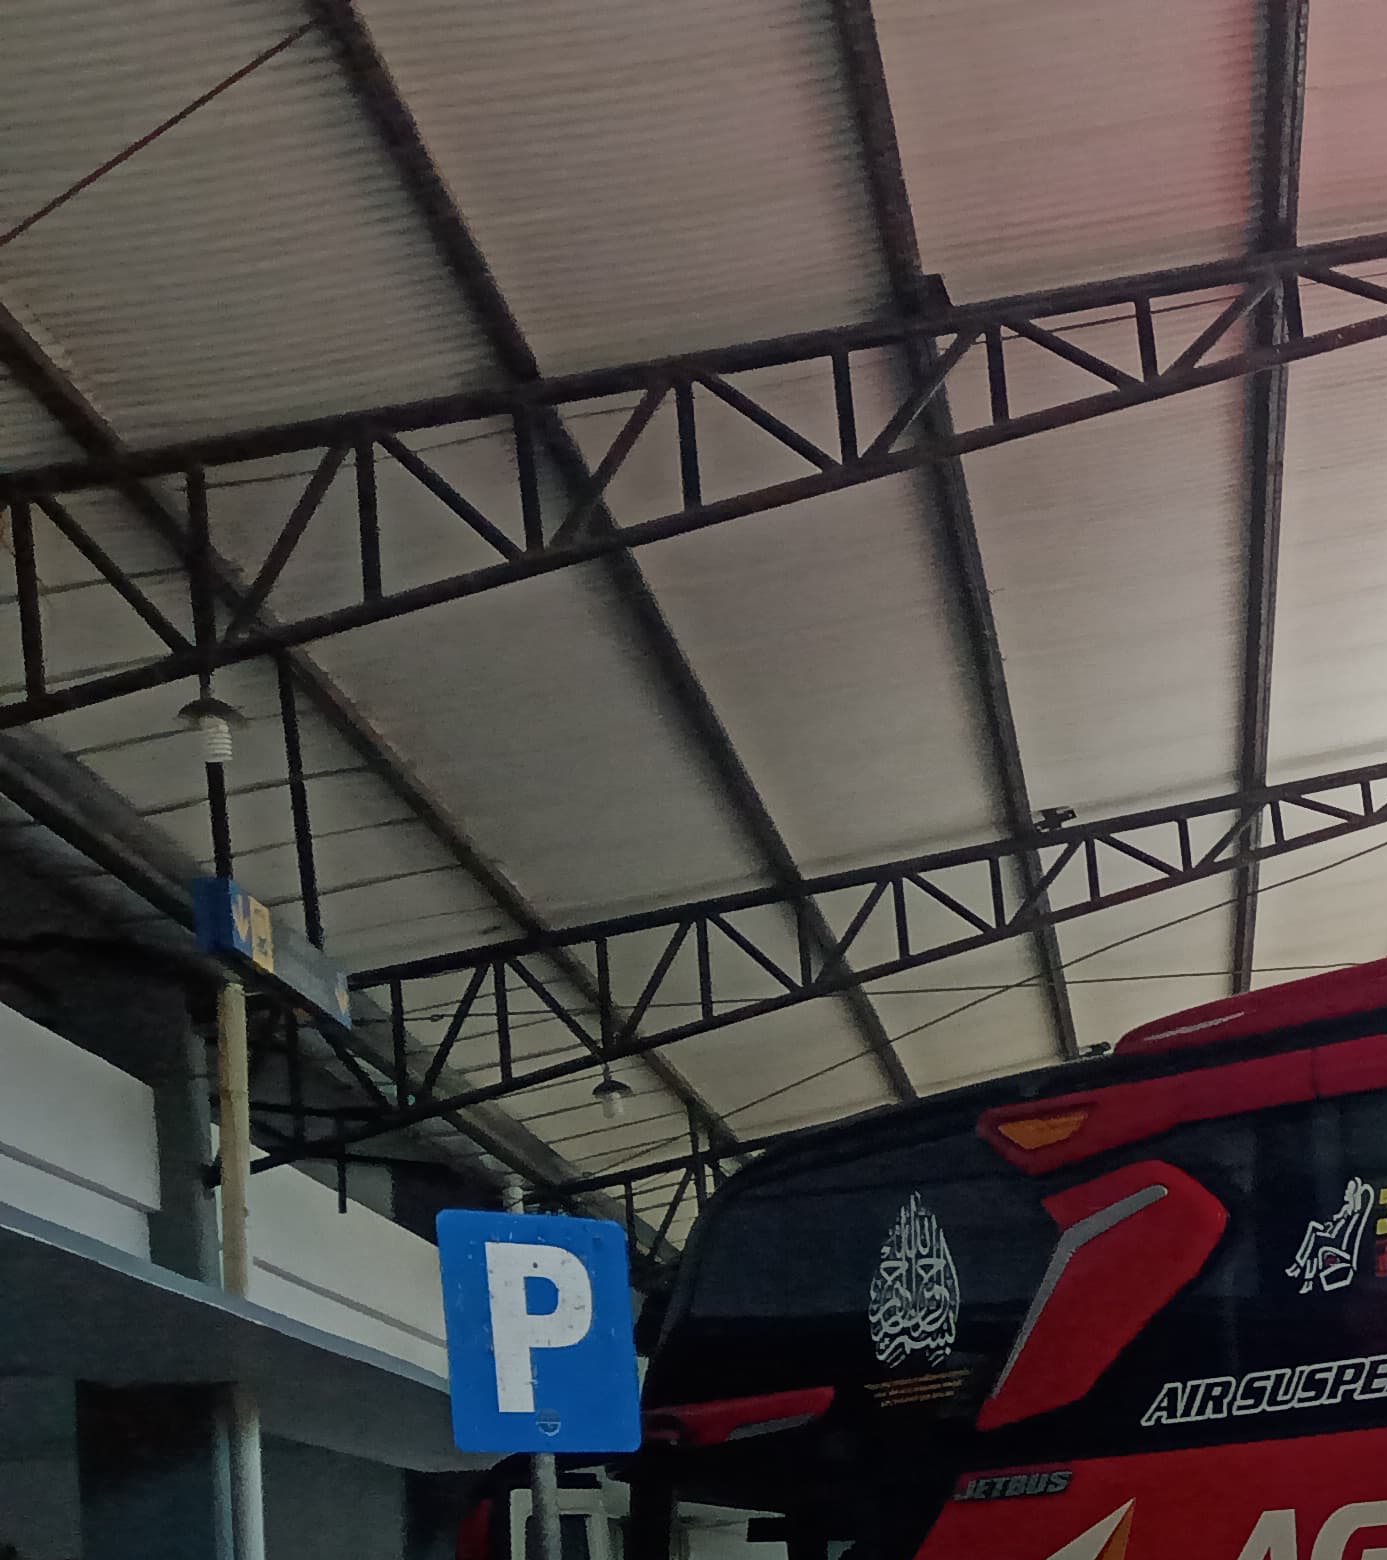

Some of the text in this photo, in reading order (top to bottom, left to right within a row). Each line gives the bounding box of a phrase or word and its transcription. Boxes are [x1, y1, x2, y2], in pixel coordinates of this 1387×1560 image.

[485, 1241, 593, 1413] P
[1140, 1376, 1237, 1427] AIR
[953, 1470, 1073, 1501] JETBUS
